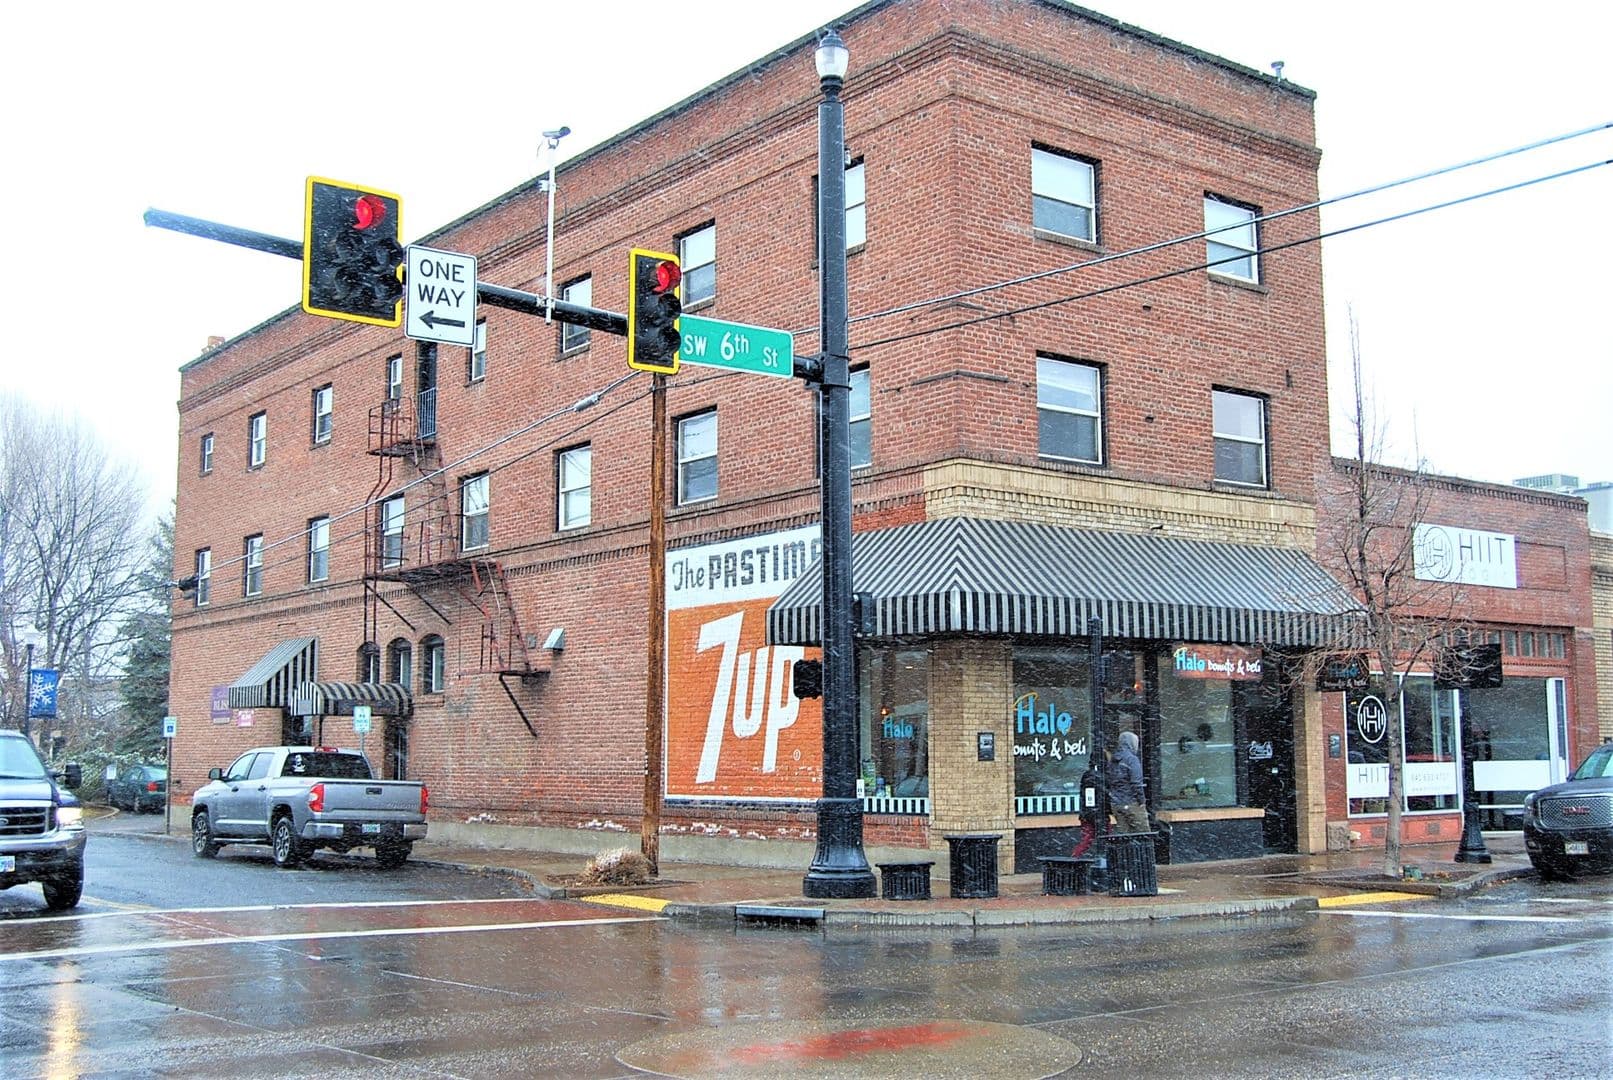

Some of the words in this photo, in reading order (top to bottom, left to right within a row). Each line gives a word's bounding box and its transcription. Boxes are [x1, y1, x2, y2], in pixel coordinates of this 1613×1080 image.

[420, 259, 464, 283] ONE
[418, 283, 465, 308] WAY
[683, 334, 707, 356] SW
[721, 331, 749, 361] 6th
[763, 346, 778, 368] St
[1459, 533, 1506, 565] HIIT
[672, 558, 705, 591] The
[1175, 648, 1206, 673] Halo
[1237, 659, 1245, 676] &
[883, 714, 913, 738] Halo
[1017, 694, 1072, 736] Halo
[1013, 737, 1046, 762] onuts
[1050, 738, 1062, 760] &
[1064, 737, 1086, 755] Deli
[1359, 766, 1389, 783] HIIT
